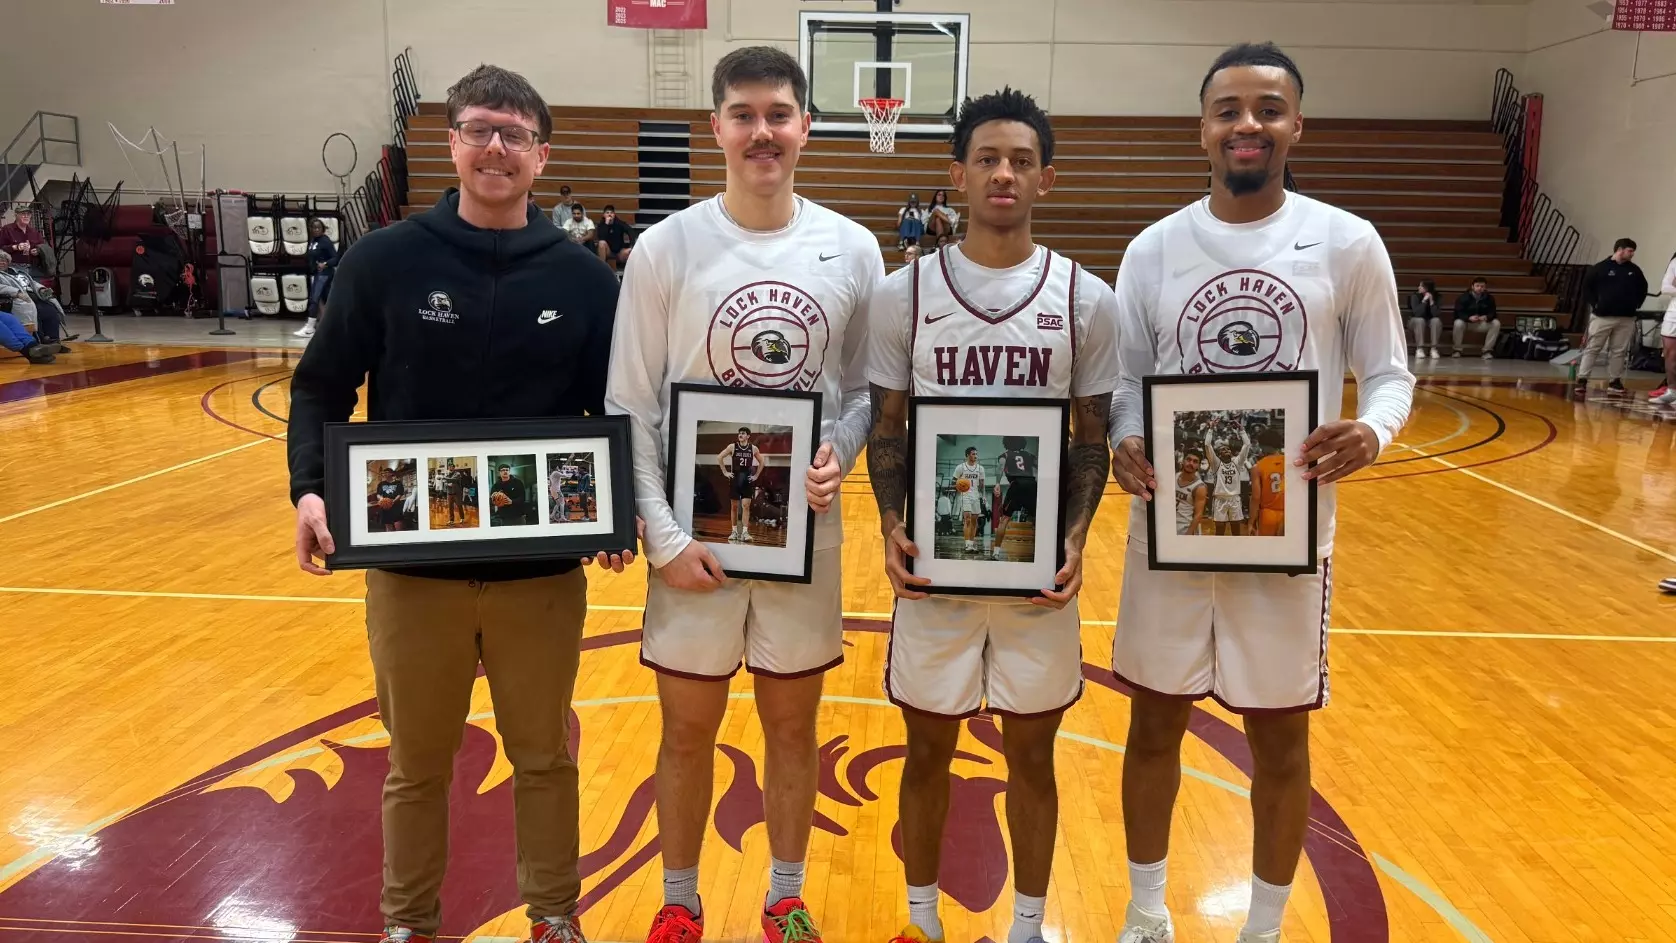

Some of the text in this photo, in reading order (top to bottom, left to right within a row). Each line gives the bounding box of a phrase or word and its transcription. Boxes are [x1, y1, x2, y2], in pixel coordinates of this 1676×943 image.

[1186, 277, 1296, 323] LOCK HAVEN
[418, 308, 436, 316] LOCK
[720, 292, 759, 329] LOCK
[769, 288, 820, 326] HAVEN
[541, 310, 557, 318] NIKE
[1037, 317, 1063, 327] PSAC
[933, 345, 1053, 387] HAVEN
[739, 457, 748, 467] 21
[1015, 455, 1025, 471] 2
[1224, 476, 1233, 485] 13
